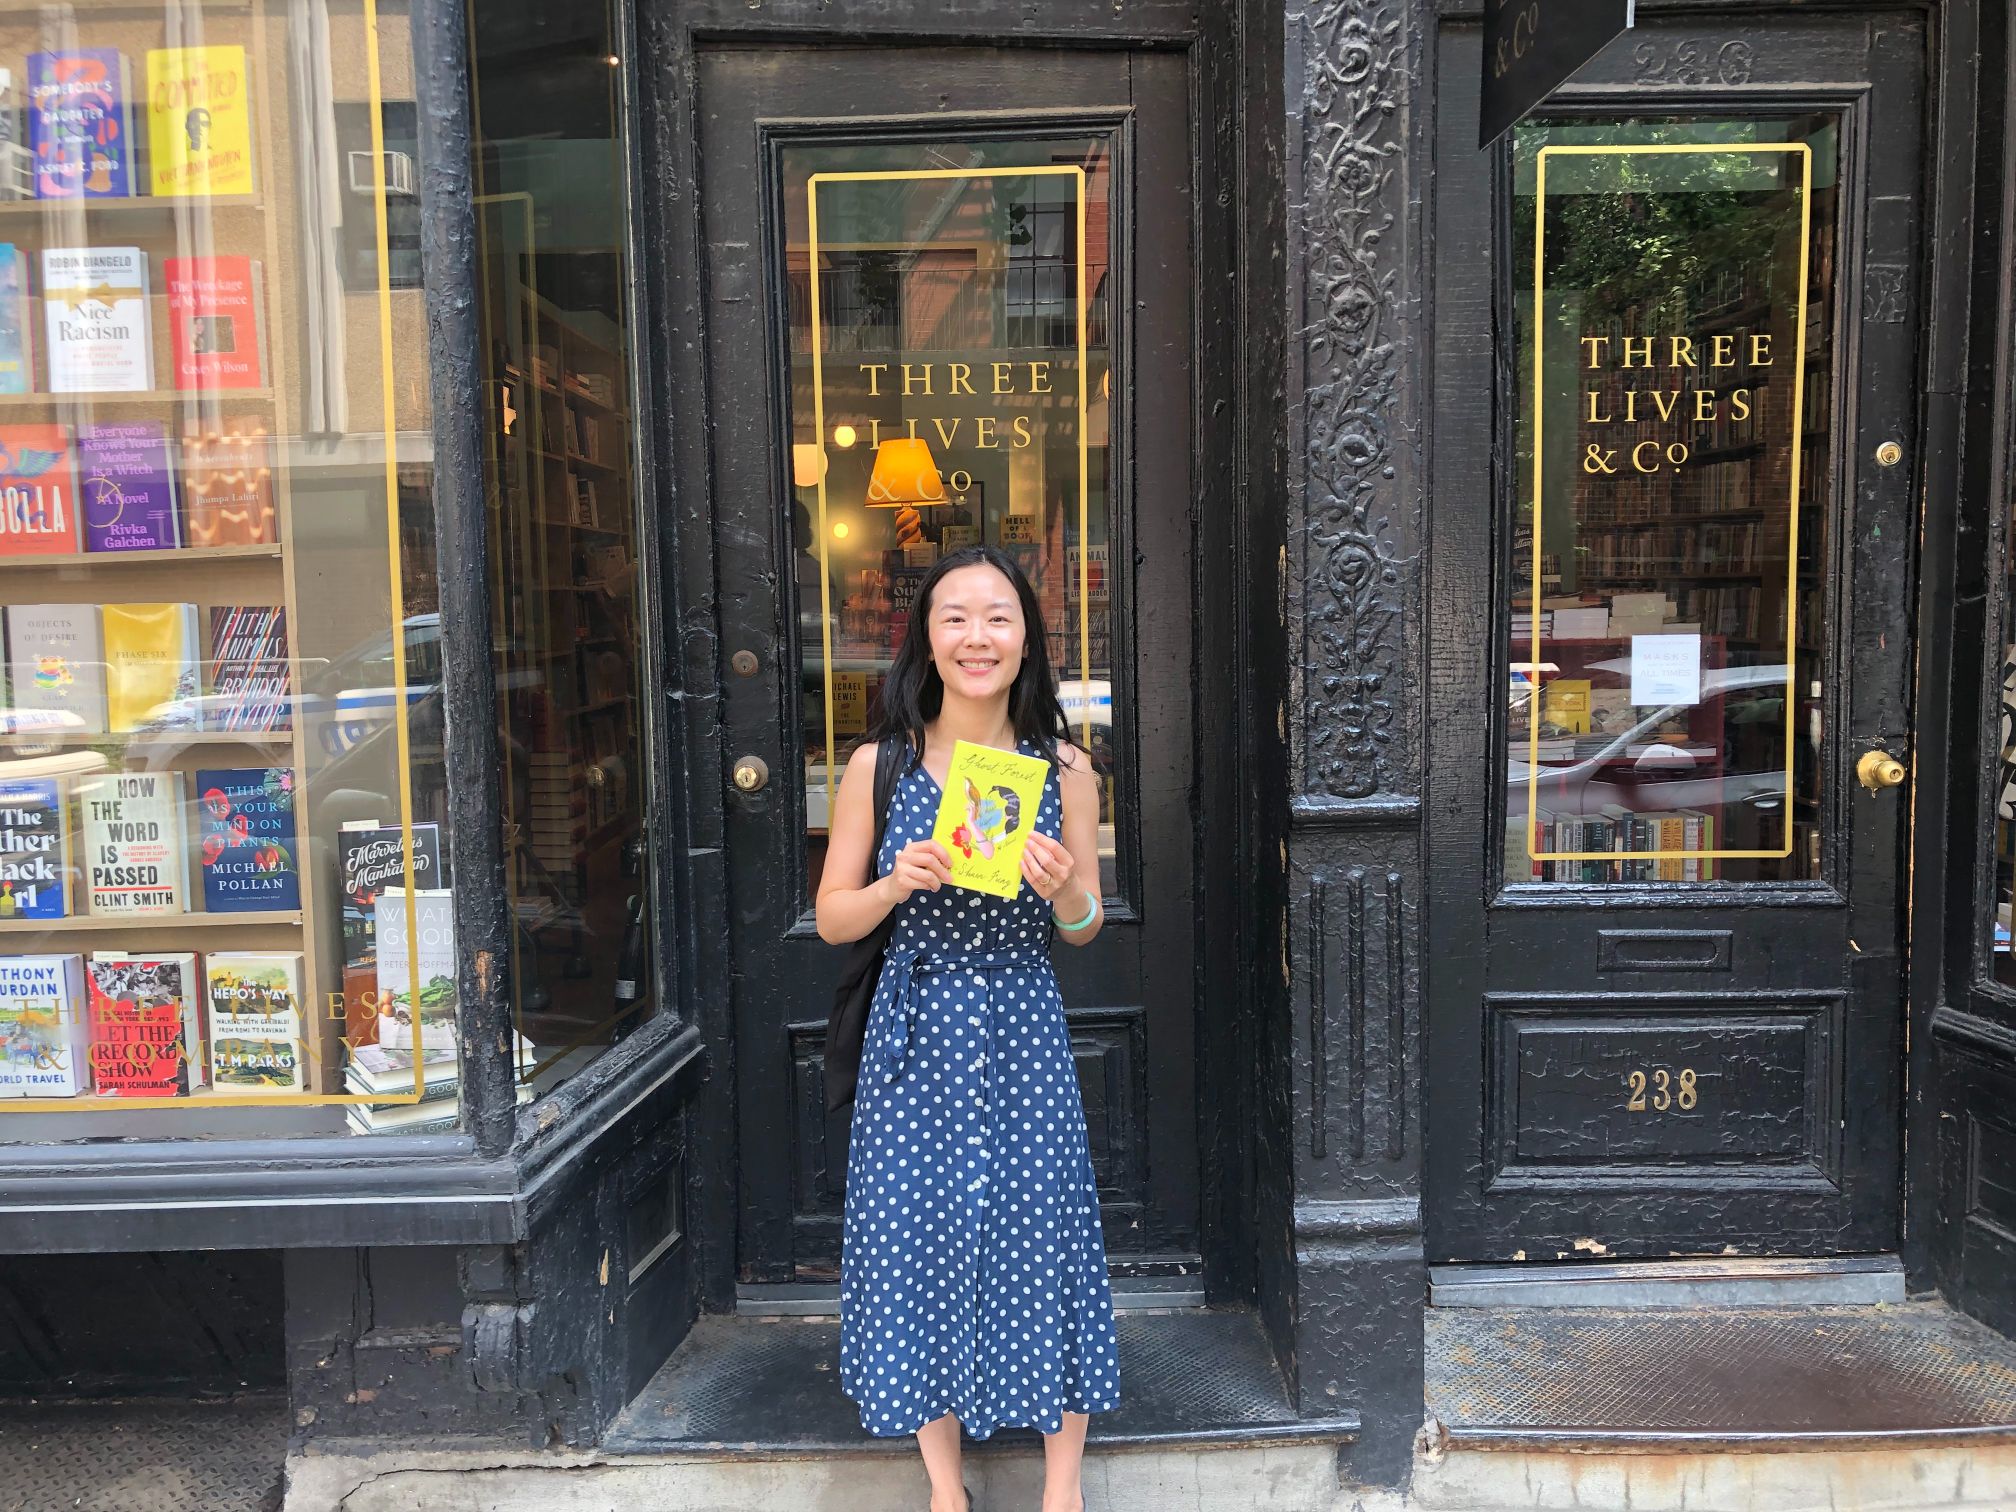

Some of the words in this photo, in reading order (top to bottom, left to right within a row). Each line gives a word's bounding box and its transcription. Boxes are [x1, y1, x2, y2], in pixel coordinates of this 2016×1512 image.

[49, 257, 80, 268] ROBIN
[83, 256, 132, 267] DIANGELO
[75, 303, 114, 321] Nice
[58, 321, 130, 342] Racism
[1581, 333, 1775, 369] THREE
[859, 361, 1053, 397] THREE
[1587, 389, 1751, 424] LIVES
[91, 425, 147, 440] Everyone
[868, 415, 1032, 450] LIVES
[84, 439, 127, 452] Knows
[128, 438, 158, 449] Your
[99, 452, 144, 464] Mother
[1583, 443, 1618, 474] &
[93, 466, 102, 477] Is
[104, 467, 113, 477] a
[117, 463, 154, 476] Witch
[867, 470, 900, 501] &
[115, 492, 149, 505] Novel
[195, 494, 229, 506] Jhumpa
[232, 492, 259, 502] Lahiri
[1006, 517, 1030, 525] HELL
[110, 524, 148, 536] Rivka
[104, 536, 156, 550] Galchen
[1070, 551, 1107, 562] ANMAL
[28, 620, 72, 628] OBJECTS
[222, 612, 281, 636] FILTHY
[41, 633, 79, 641] DESIRE
[115, 650, 147, 659] PHASE
[151, 650, 168, 659] SIX
[217, 636, 284, 660] ANIMALS
[1643, 652, 1689, 661] MASKS
[1641, 669, 1660, 678] ALL
[1662, 669, 1692, 678] TIMES
[220, 676, 290, 700] BRANDON
[833, 692, 857, 701] LEWIS
[225, 702, 285, 727] TAYLOR
[959, 754, 998, 774] Ghost
[1000, 762, 1038, 783] Forest
[117, 777, 155, 798] HOW
[225, 785, 264, 797] THIS
[91, 800, 123, 821] THE
[233, 802, 278, 813] YOUR
[0, 808, 43, 826] The
[107, 821, 159, 843] WORD
[212, 819, 254, 831] MIND
[260, 819, 282, 830] ON
[217, 836, 280, 848] PLANTS
[100, 845, 119, 864] IS
[346, 836, 423, 872] Marvelus
[212, 861, 289, 874] MICHAEL
[93, 865, 158, 887] PASSED
[218, 878, 284, 891] POLLAN
[94, 893, 129, 907] CLINT
[133, 892, 174, 906] SMITH
[381, 907, 453, 922] WHAT'
[384, 960, 410, 970] PETER
[417, 960, 455, 970] HOFFMA
[242, 979, 257, 988] The
[261, 988, 288, 1001] WAY
[13, 995, 193, 1026] THREE
[230, 991, 377, 1021] LIVES
[99, 1025, 132, 1041] LET
[135, 1025, 175, 1041] THE
[34, 1042, 69, 1071] &
[87, 1036, 364, 1069] COMPANY
[98, 1043, 178, 1060] RECORD
[248, 1053, 293, 1068] PARKS
[98, 1061, 154, 1078] SHOW
[26, 1074, 66, 1083] TRAVEL
[99, 1082, 125, 1090] SARAH
[127, 1081, 170, 1089] SCHULMAN
[1627, 1068, 1698, 1112] 238
